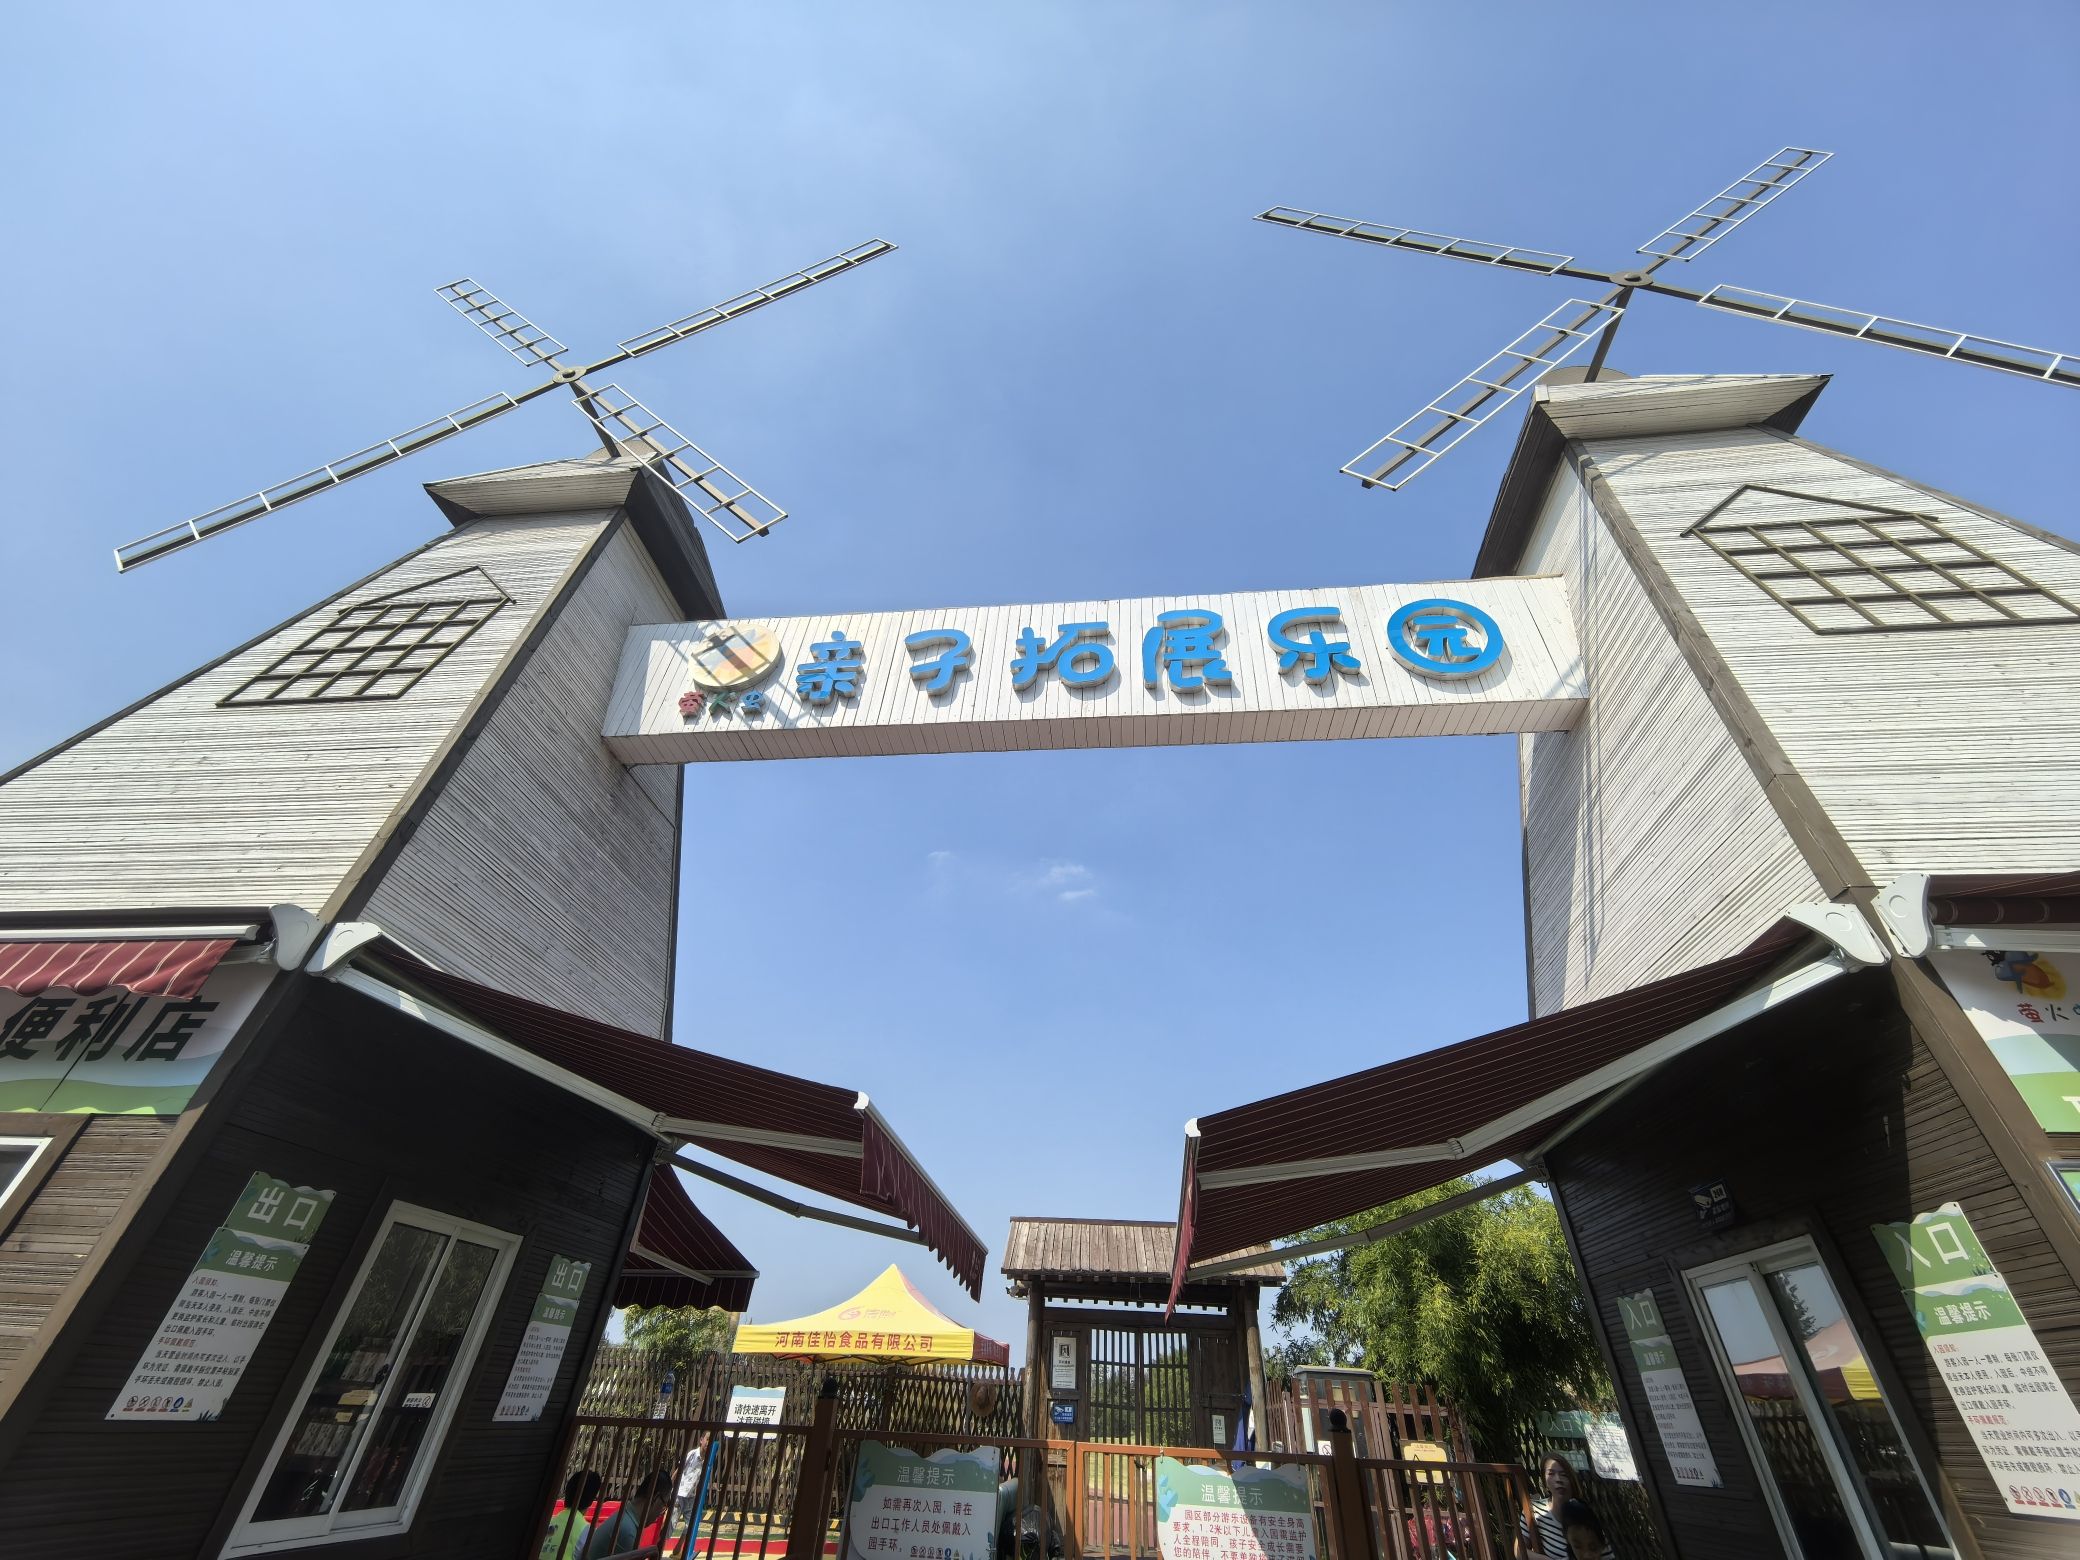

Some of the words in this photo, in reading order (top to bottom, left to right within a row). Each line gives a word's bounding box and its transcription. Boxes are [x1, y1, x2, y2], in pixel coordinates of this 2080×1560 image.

[796, 598, 1505, 706] 亲子拓展乐园
[0, 996, 220, 1062] 便利店
[247, 1186, 319, 1231] 出口
[1894, 1222, 1969, 1272] 入口
[226, 1249, 279, 1272] 温馨提示
[551, 1263, 583, 1292] 出口
[1626, 1301, 1657, 1330] 入口
[1934, 1301, 1991, 1325] 温馨提示
[774, 1331, 933, 1353] 河南佳怡食品有限公司
[734, 1404, 777, 1416] 请快速离开
[897, 1466, 955, 1486] 温馨提示
[1201, 1484, 1264, 1506] 温馨提示
[882, 1497, 973, 1517] 如需再次入园，请在
[870, 1516, 971, 1536] 出口工作人员处佩戴入
[1185, 1510, 1304, 1529] 园区部分游乐设备有安全身高
